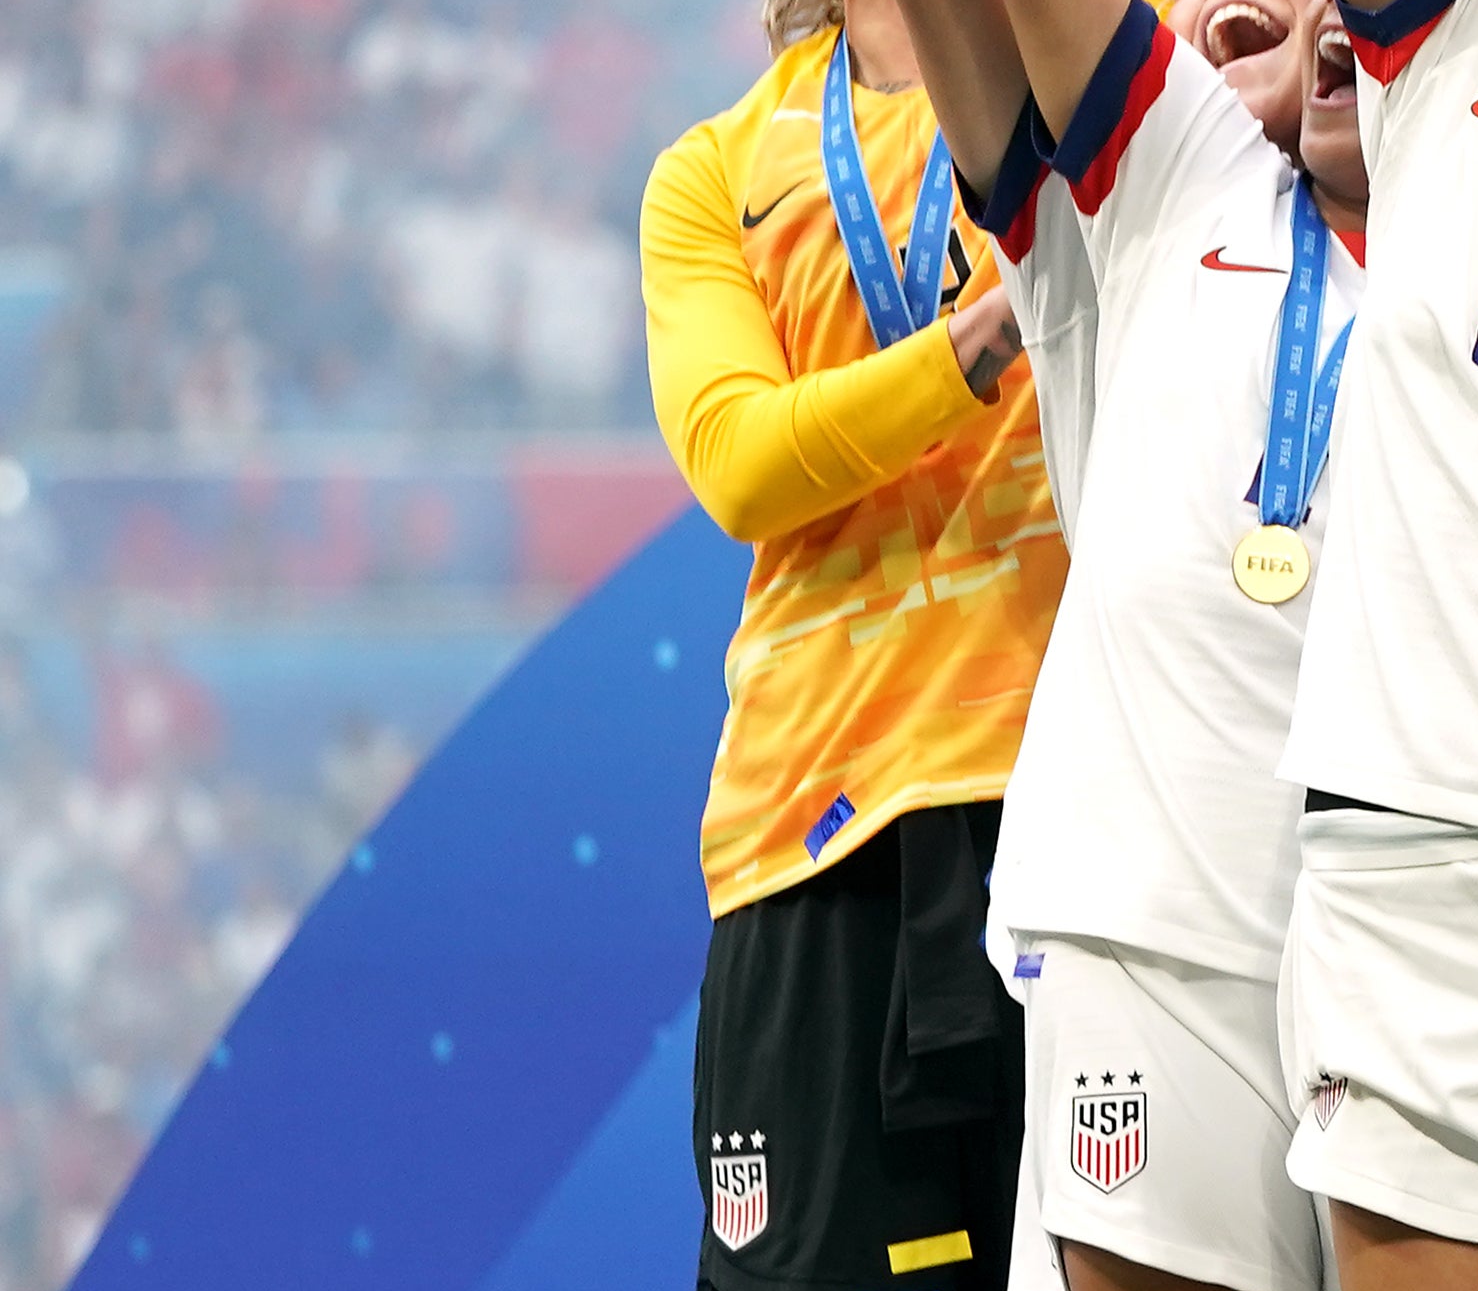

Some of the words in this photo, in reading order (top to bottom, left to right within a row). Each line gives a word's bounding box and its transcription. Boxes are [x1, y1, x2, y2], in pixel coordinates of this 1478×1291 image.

[1247, 555, 1295, 575] FIFA
[1077, 1099, 1140, 1138] USA
[716, 1158, 764, 1194] USA
